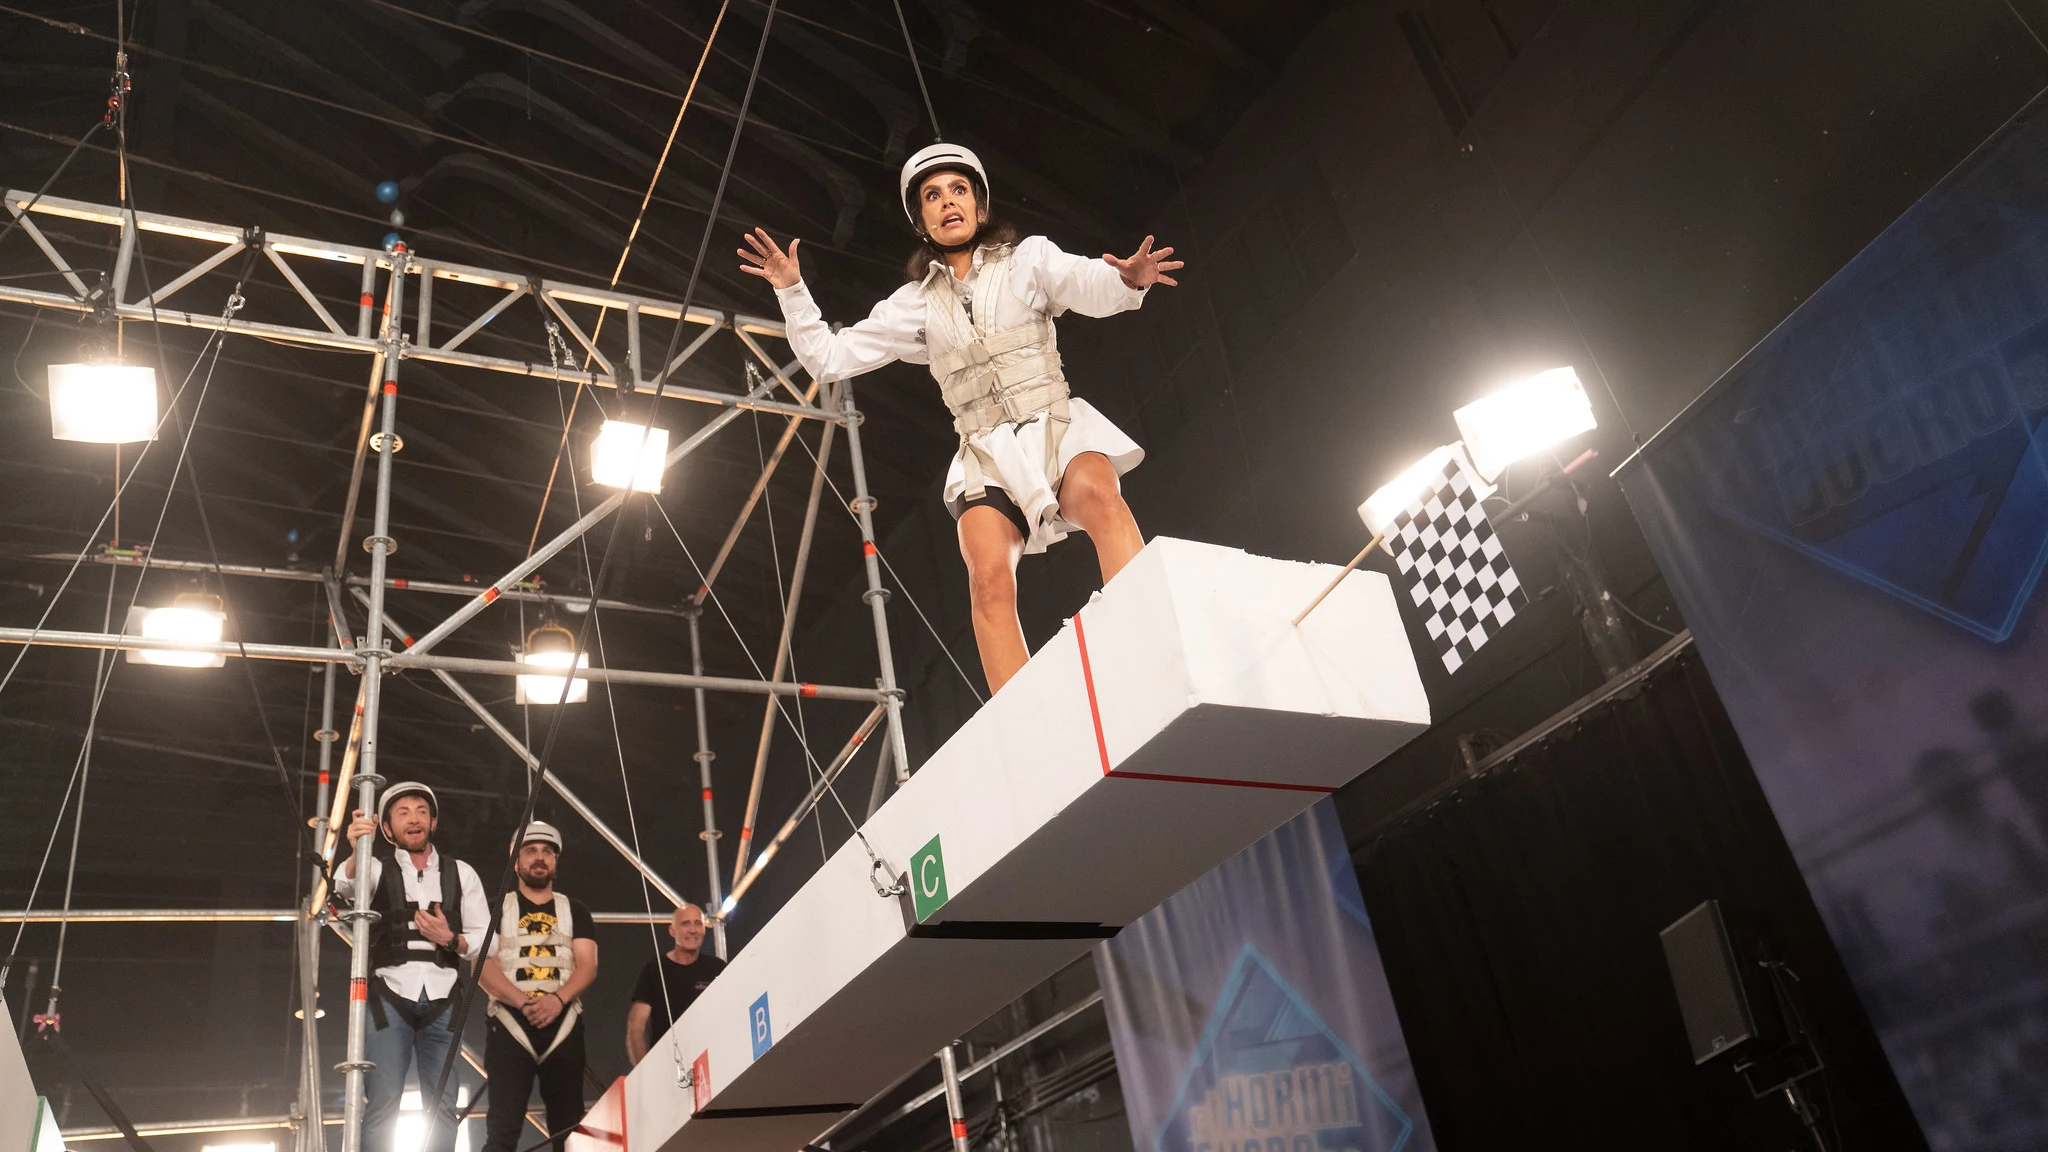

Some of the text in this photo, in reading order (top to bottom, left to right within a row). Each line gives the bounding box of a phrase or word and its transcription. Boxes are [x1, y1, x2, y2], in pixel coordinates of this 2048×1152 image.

[921, 854, 939, 897] C
[755, 1006, 767, 1043] B
[698, 1063, 709, 1092] A
